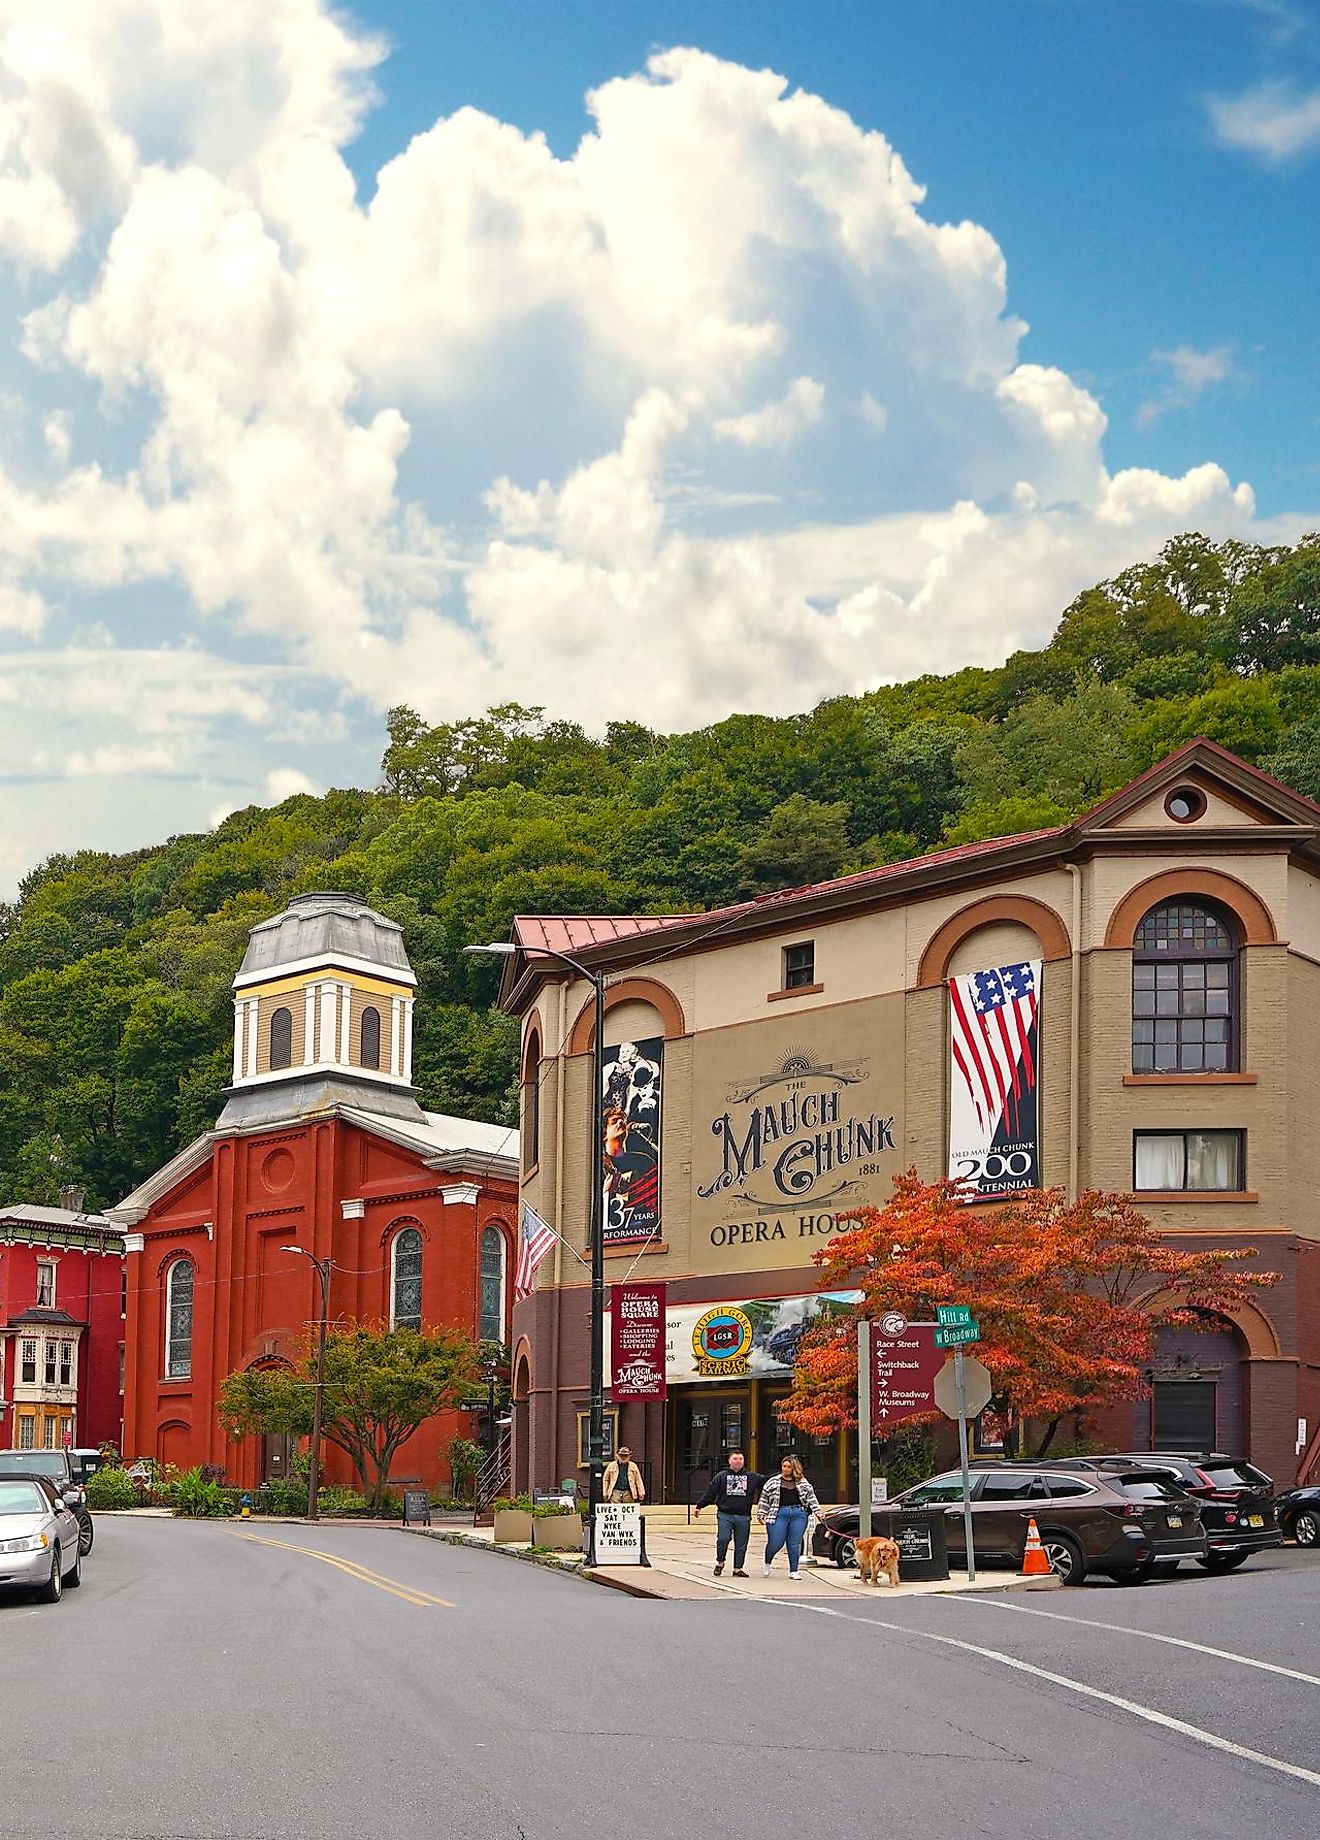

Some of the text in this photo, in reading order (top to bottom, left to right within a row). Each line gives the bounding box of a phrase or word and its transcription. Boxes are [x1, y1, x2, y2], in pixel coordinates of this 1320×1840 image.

[785, 1081, 806, 1091] THE
[697, 1091, 841, 1199] MAUCH
[952, 1141, 1035, 1158] OLD MAUCH CHUNK
[773, 1113, 898, 1196] CHUNK
[859, 1164, 880, 1176] 1881
[957, 1151, 1032, 1182] 200
[978, 1179, 1034, 1193] NTENNIAL
[633, 1212, 655, 1221] YEARS
[603, 1227, 656, 1240] RFORMANCE
[710, 1214, 864, 1247] OPERA HOUS
[939, 1310, 969, 1324] Hill Rd
[728, 1309, 750, 1342] GORGE
[713, 1332, 733, 1341] LGSR
[936, 1327, 978, 1344] W Broadway
[701, 1360, 744, 1369] SCENIC
[701, 1366, 744, 1375] RAILWAY
[877, 1361, 919, 1369] Switchback
[613, 1367, 651, 1385] MAUCH
[632, 1372, 663, 1387] CHUNK
[892, 1391, 930, 1400] Broadway
[597, 1506, 612, 1514] LIVE
[604, 1522, 621, 1530] NYKE
